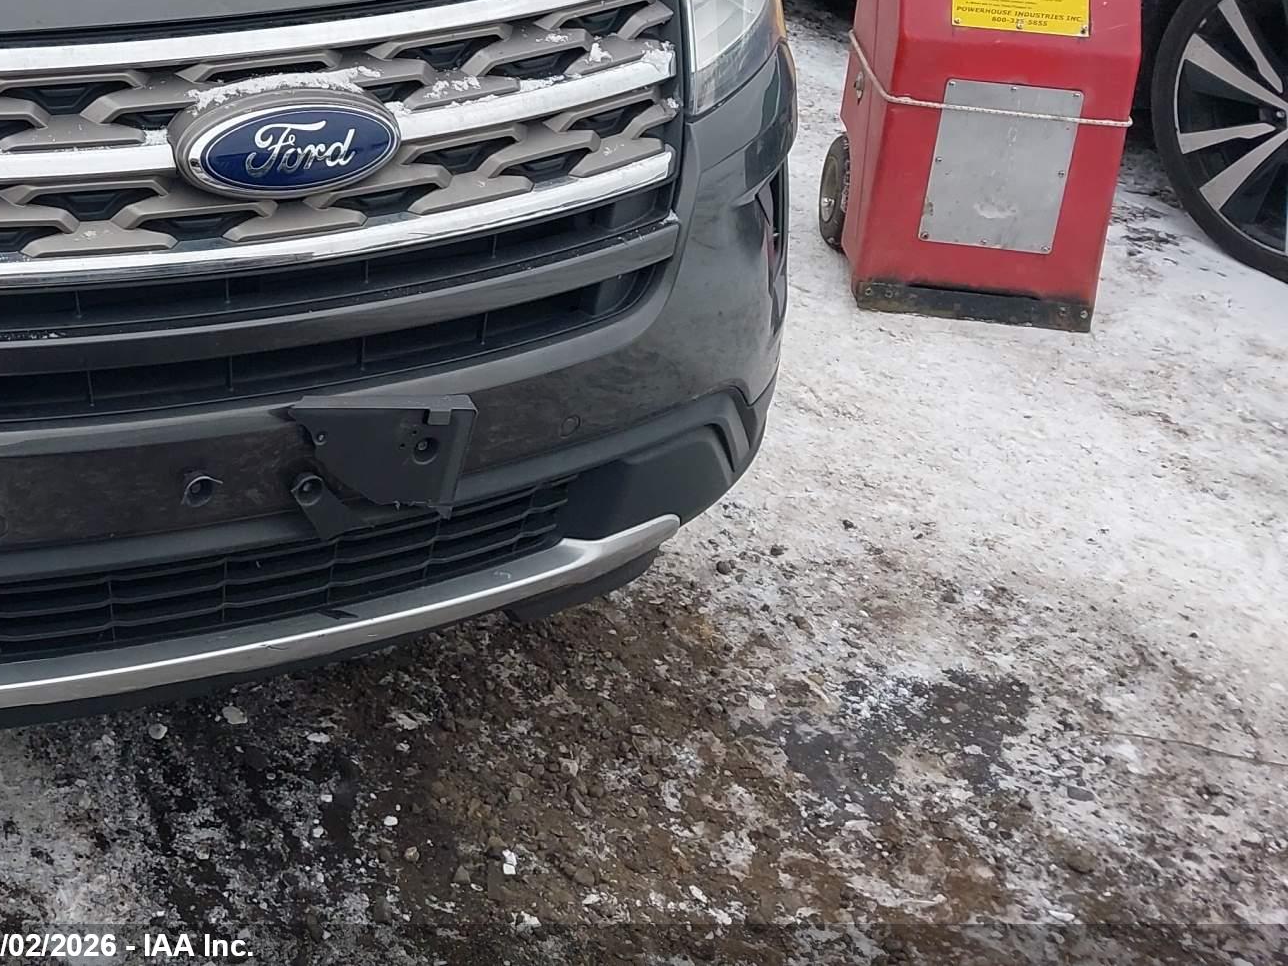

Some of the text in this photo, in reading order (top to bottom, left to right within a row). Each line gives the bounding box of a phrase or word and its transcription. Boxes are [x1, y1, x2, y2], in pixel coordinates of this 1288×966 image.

[956, 5, 1012, 16] POWERHOUSE
[1014, 10, 1065, 21] INDUSTRIES
[245, 120, 356, 178] Ford
